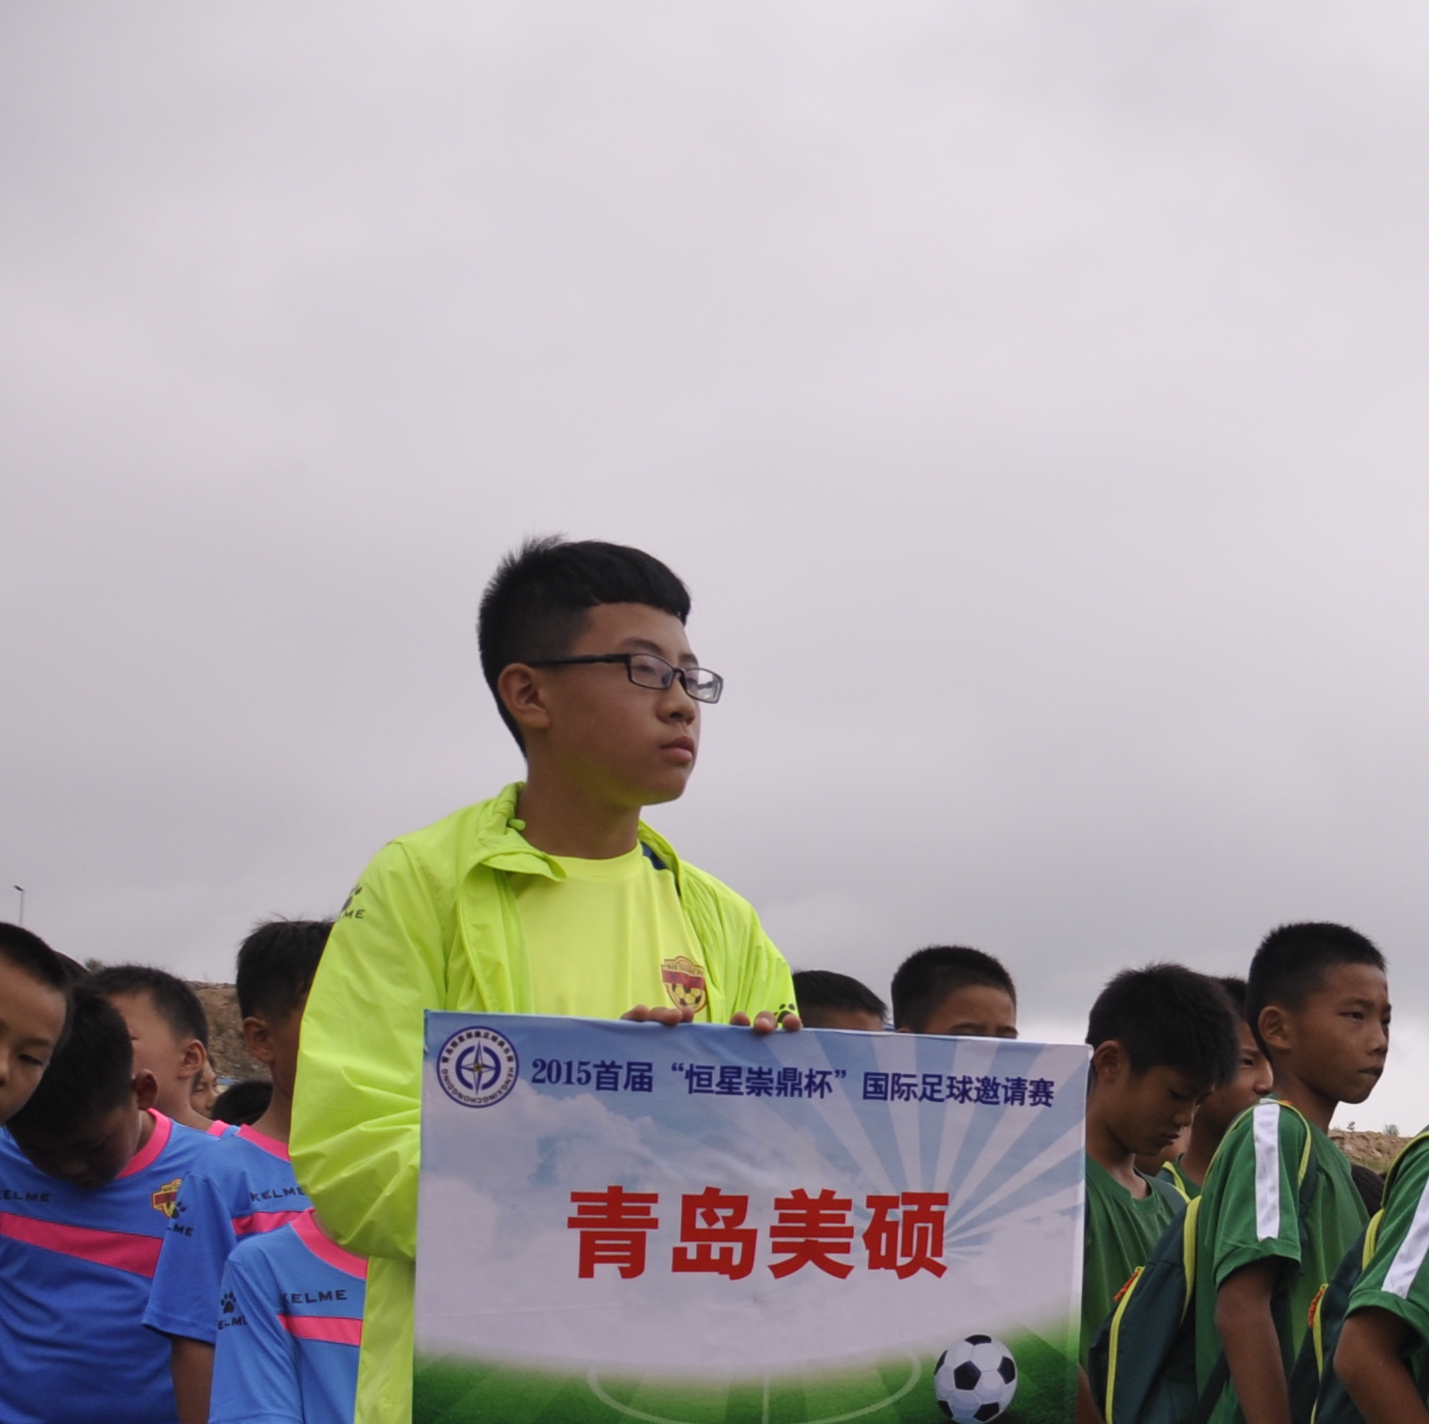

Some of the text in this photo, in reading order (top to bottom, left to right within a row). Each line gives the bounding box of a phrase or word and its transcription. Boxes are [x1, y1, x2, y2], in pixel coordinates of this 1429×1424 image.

[0, 1189, 51, 1203] ELME
[567, 1185, 949, 1280] 青岛美硕
